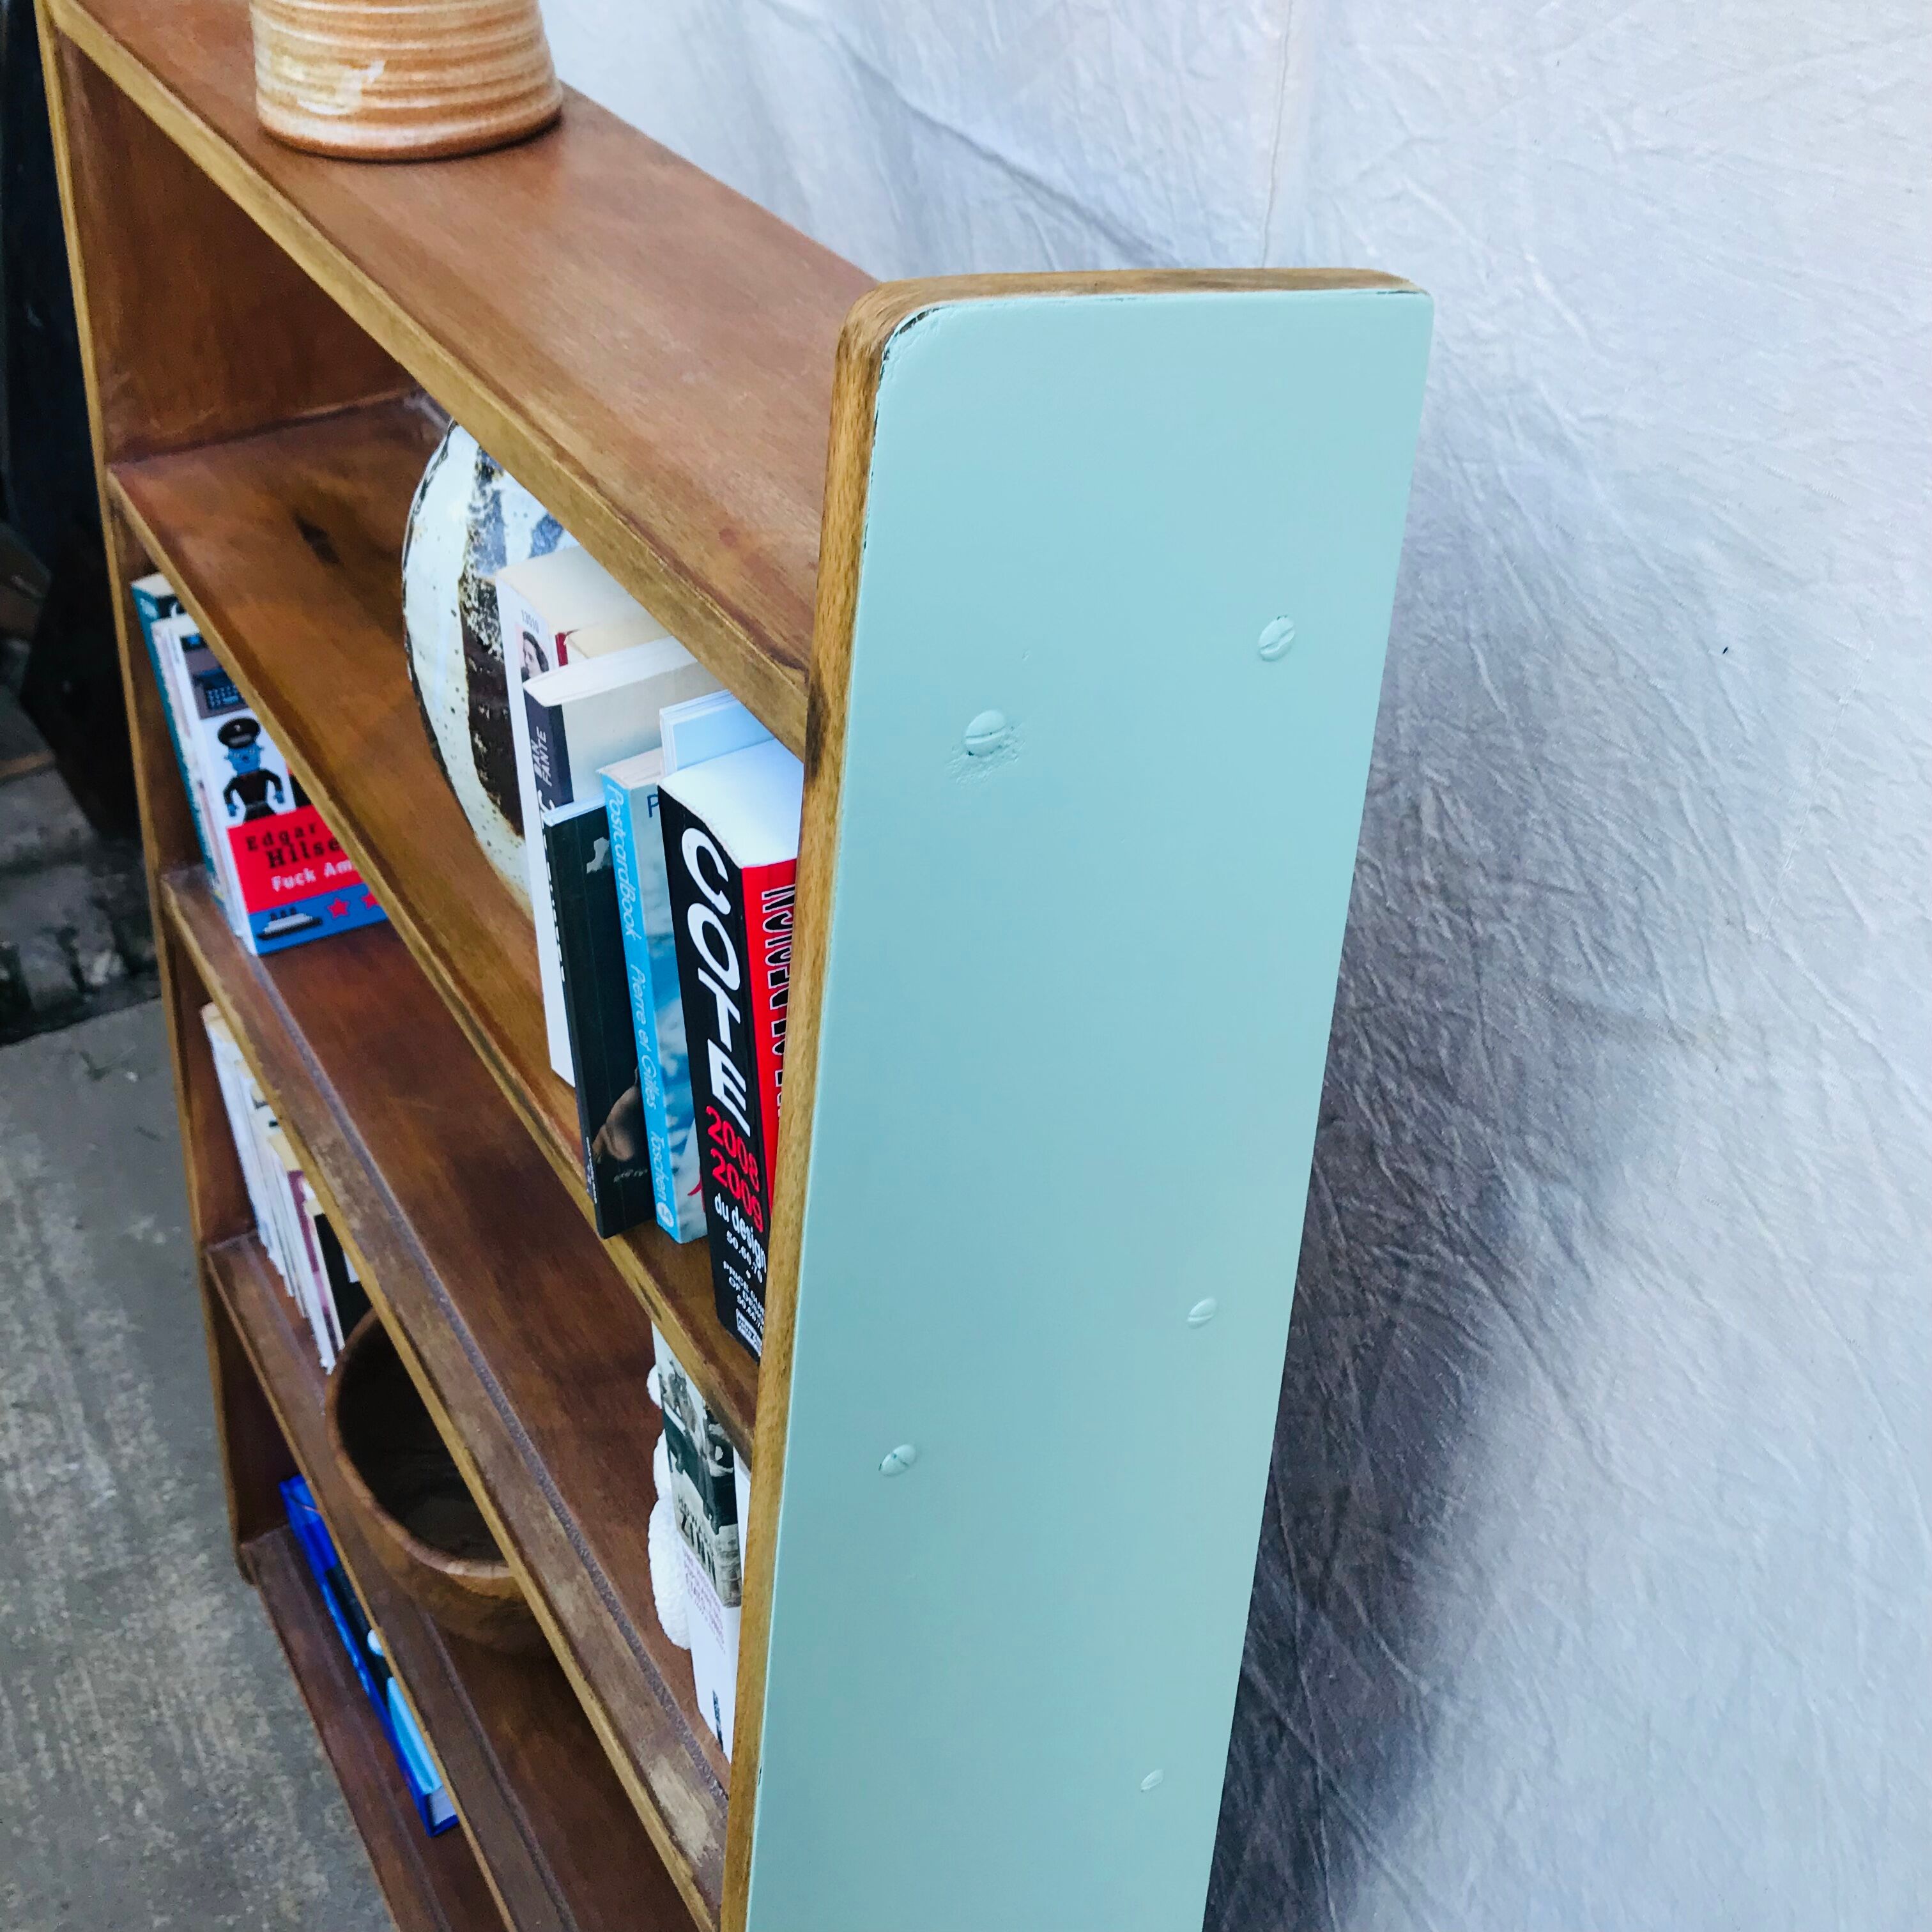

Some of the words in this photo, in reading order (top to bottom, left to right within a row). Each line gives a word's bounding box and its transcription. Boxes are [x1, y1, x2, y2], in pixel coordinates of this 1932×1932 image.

[536, 726, 552, 786] FANTE
[246, 823, 316, 852] Edgar
[271, 868, 316, 892] Fuck
[631, 964, 646, 1025] Pierre
[639, 1029, 652, 1052] et
[641, 1055, 660, 1110] Gilles
[650, 1131, 670, 1201] Taschen
[706, 1106, 760, 1192] 2008
[710, 1148, 763, 1232] 2009
[714, 1193, 729, 1222] du
[732, 1206, 767, 1273] design
